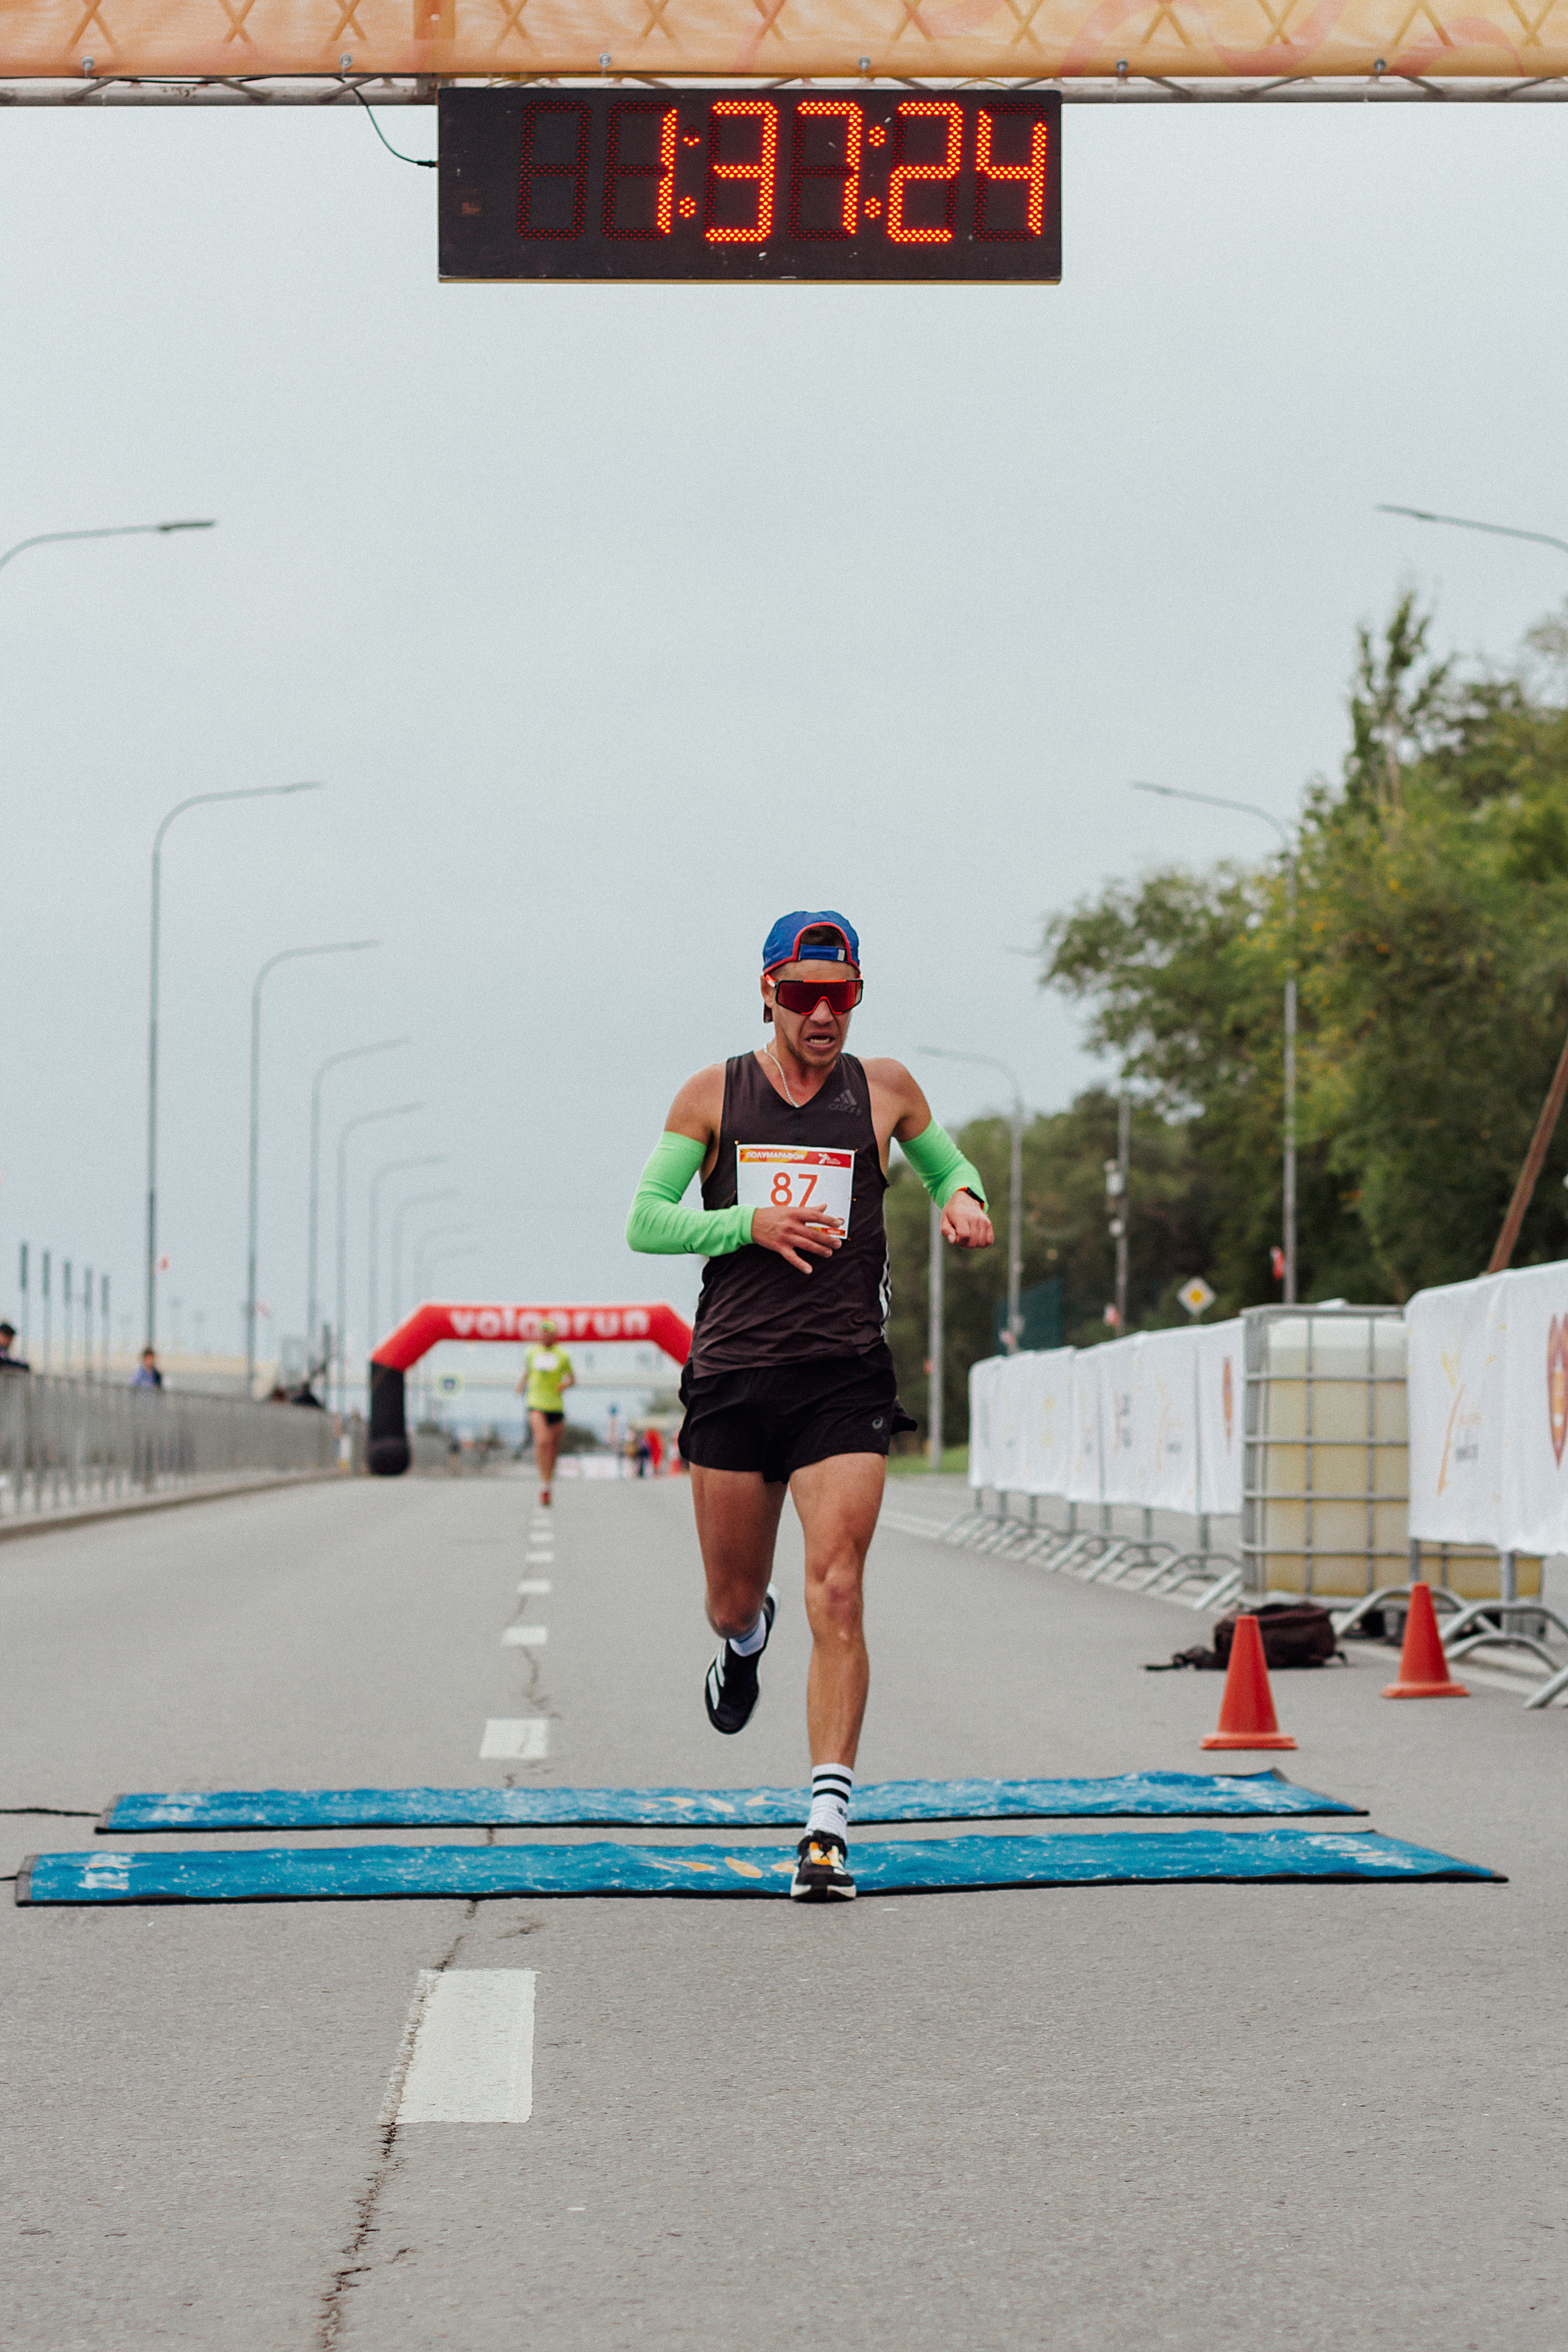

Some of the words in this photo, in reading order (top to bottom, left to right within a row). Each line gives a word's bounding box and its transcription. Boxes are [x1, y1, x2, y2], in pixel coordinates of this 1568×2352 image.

[657, 100, 1047, 243] 1:37:24
[746, 1152, 804, 1160] ПОЛУМАРАФОН
[771, 1172, 818, 1207] 87
